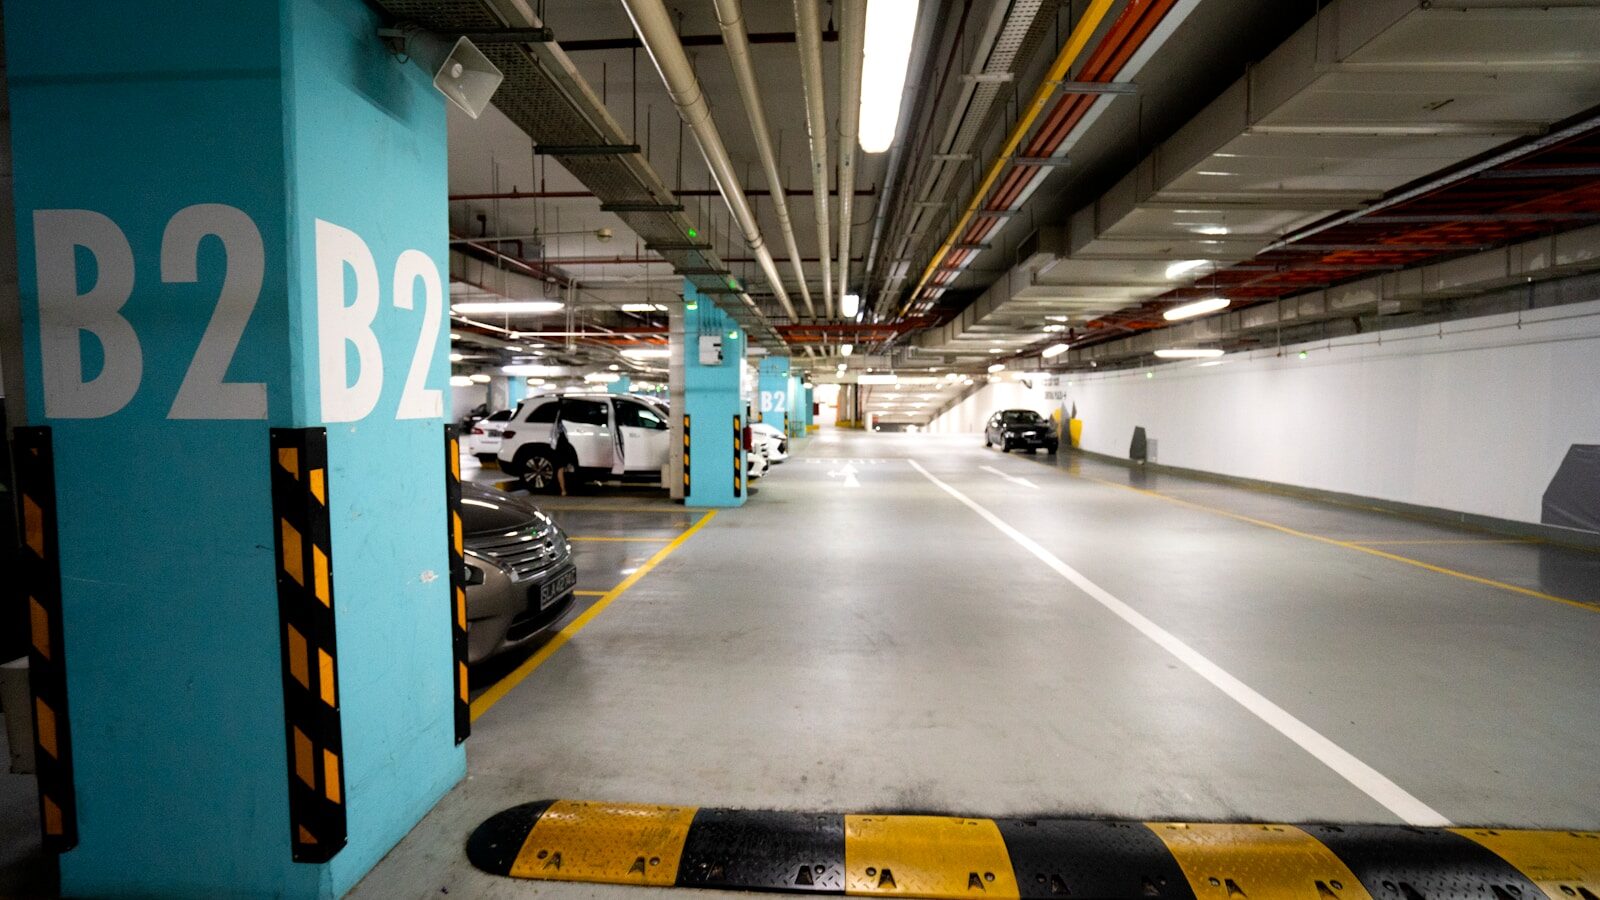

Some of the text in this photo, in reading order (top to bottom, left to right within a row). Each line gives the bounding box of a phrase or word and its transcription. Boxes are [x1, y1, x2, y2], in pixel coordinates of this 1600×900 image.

[33, 203, 269, 420] B2
[315, 218, 444, 423] B2
[761, 390, 785, 412] B2
